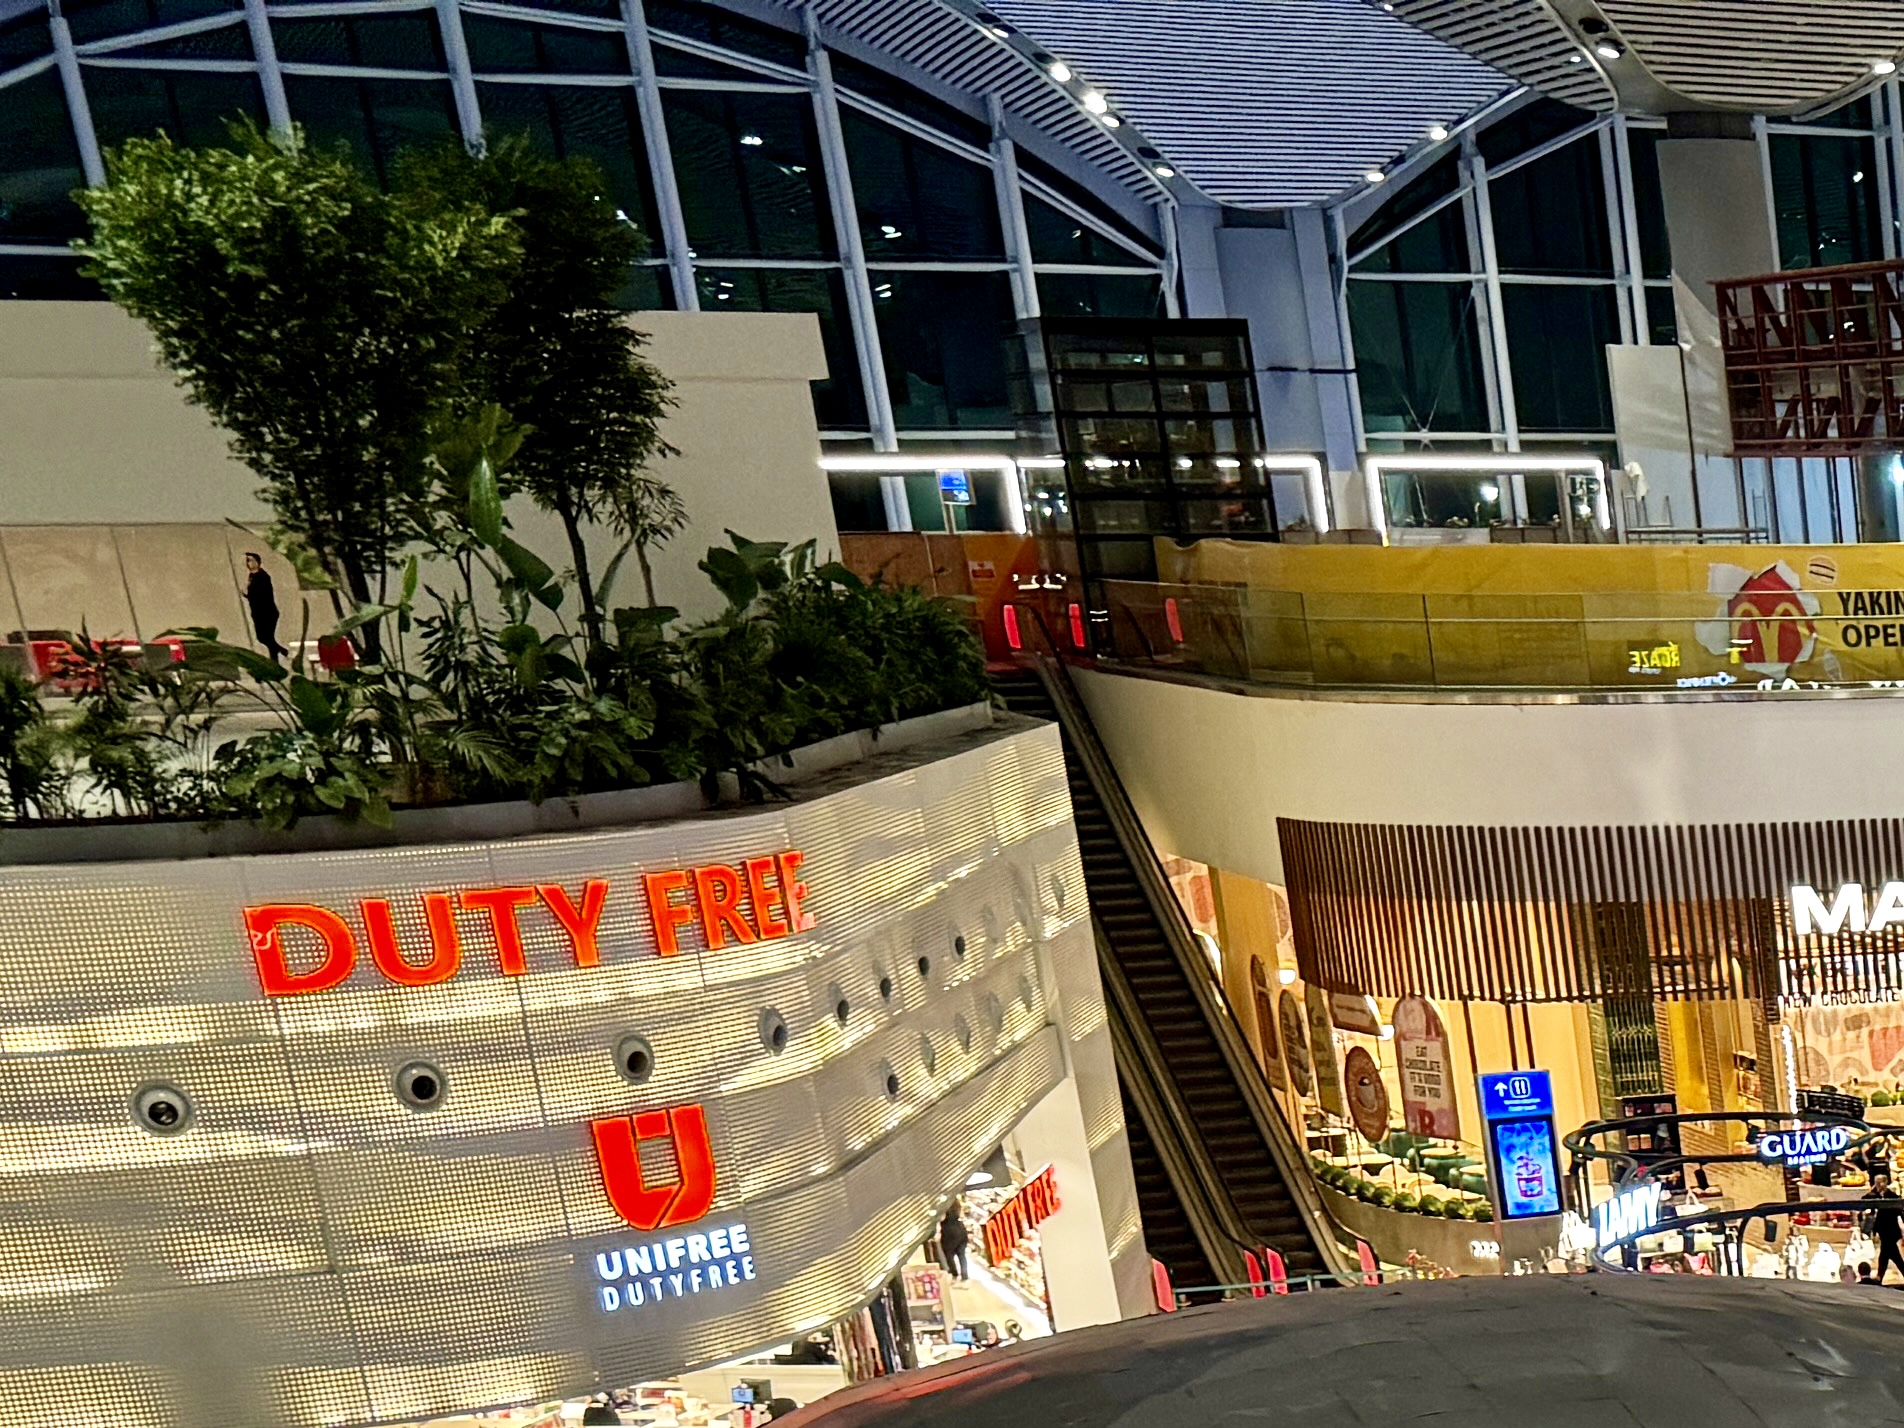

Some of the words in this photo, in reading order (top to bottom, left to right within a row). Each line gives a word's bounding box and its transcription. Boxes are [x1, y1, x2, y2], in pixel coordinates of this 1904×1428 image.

[244, 878, 609, 997] DUTY
[640, 850, 818, 956] FREE
[1761, 1127, 1849, 1158] GUARD
[984, 1190, 1030, 1268] DUTY
[1599, 1181, 1663, 1248] LAMY
[597, 1223, 752, 1281] UNIFREE
